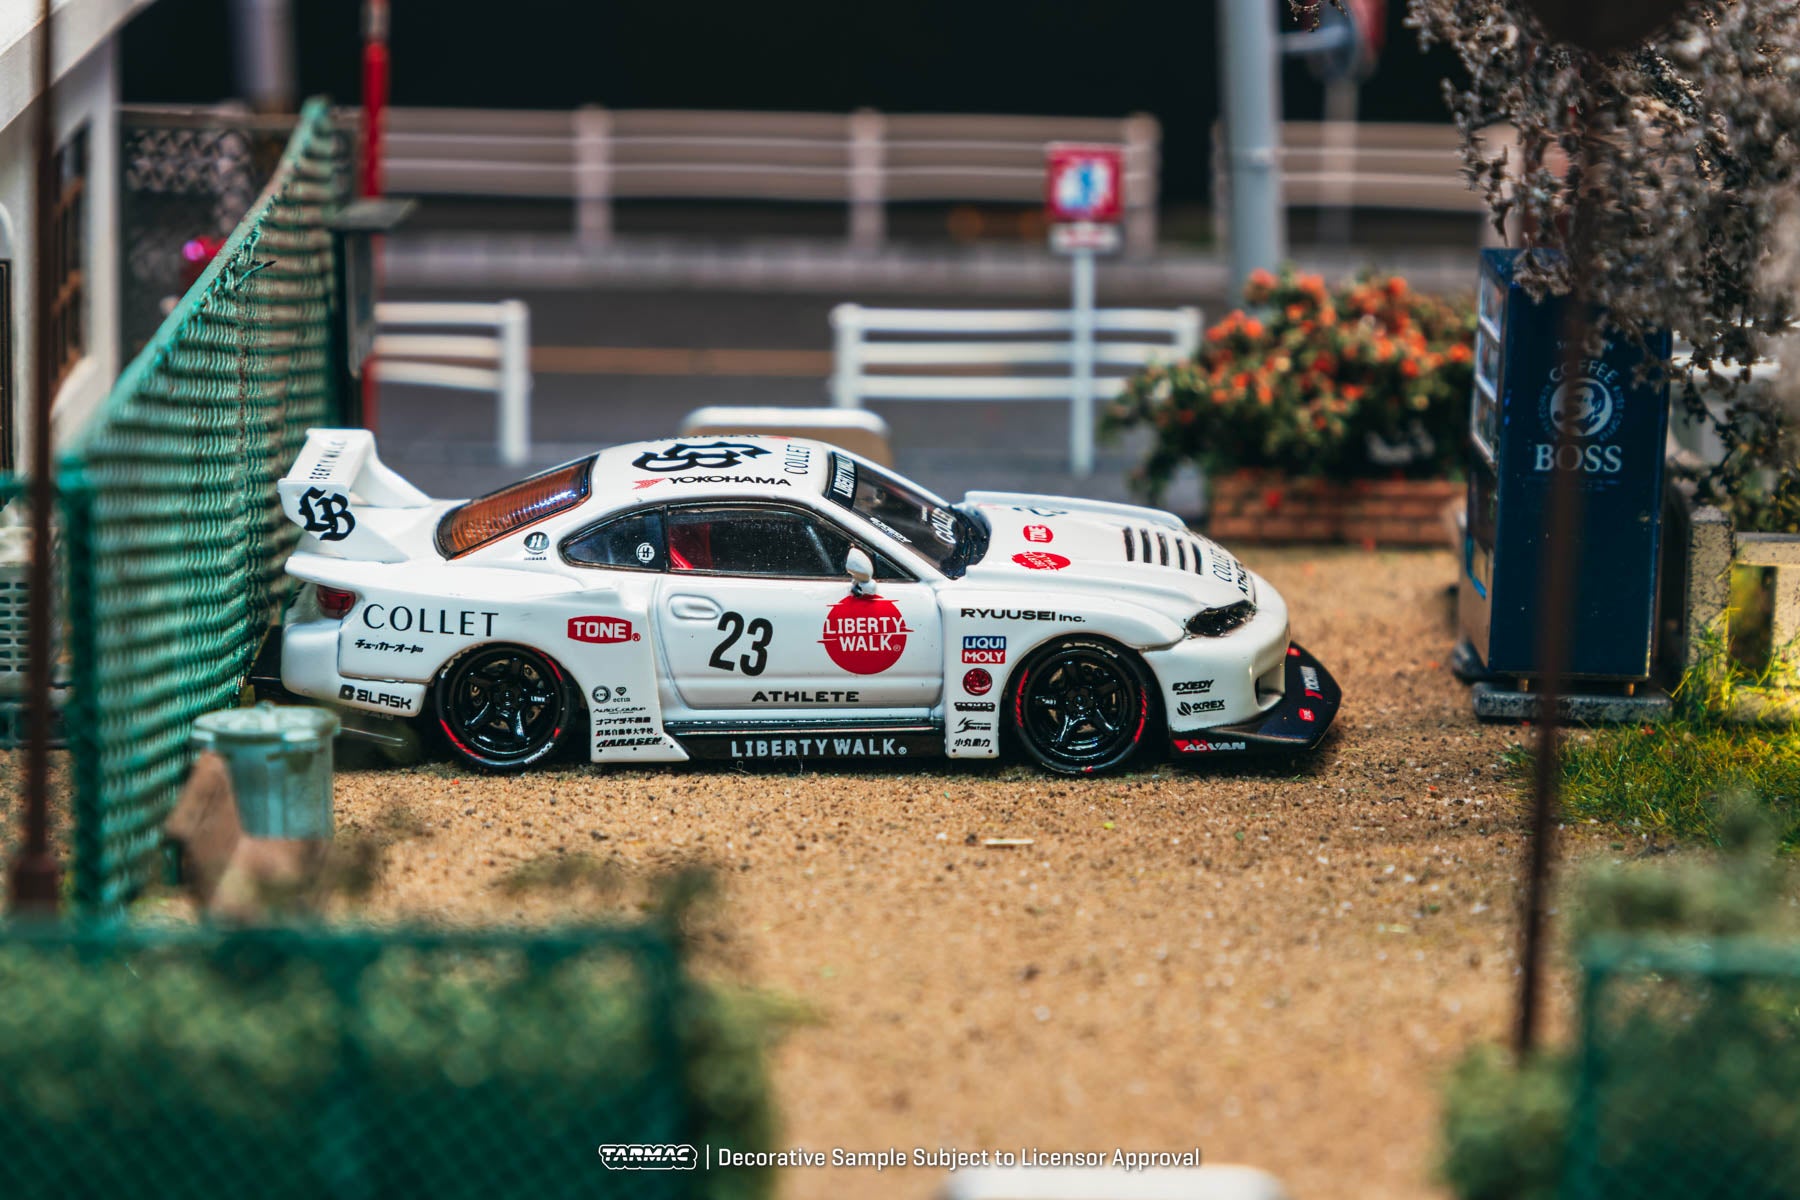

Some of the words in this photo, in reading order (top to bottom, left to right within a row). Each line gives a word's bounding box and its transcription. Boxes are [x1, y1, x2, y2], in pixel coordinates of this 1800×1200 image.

[1534, 443, 1622, 472] BOSS
[669, 475, 792, 487] YOKOHAMA
[363, 603, 500, 637] COLLET
[961, 608, 1055, 621] RYUUSEI
[1058, 613, 1086, 623] Inc.
[573, 621, 627, 639] TONE
[826, 616, 905, 635] LIBERTY
[708, 611, 773, 677] 23
[964, 637, 1005, 649] LIQUI
[963, 651, 1004, 663] MOLY
[356, 688, 412, 710] BLASK
[751, 690, 860, 703] ATHLETE
